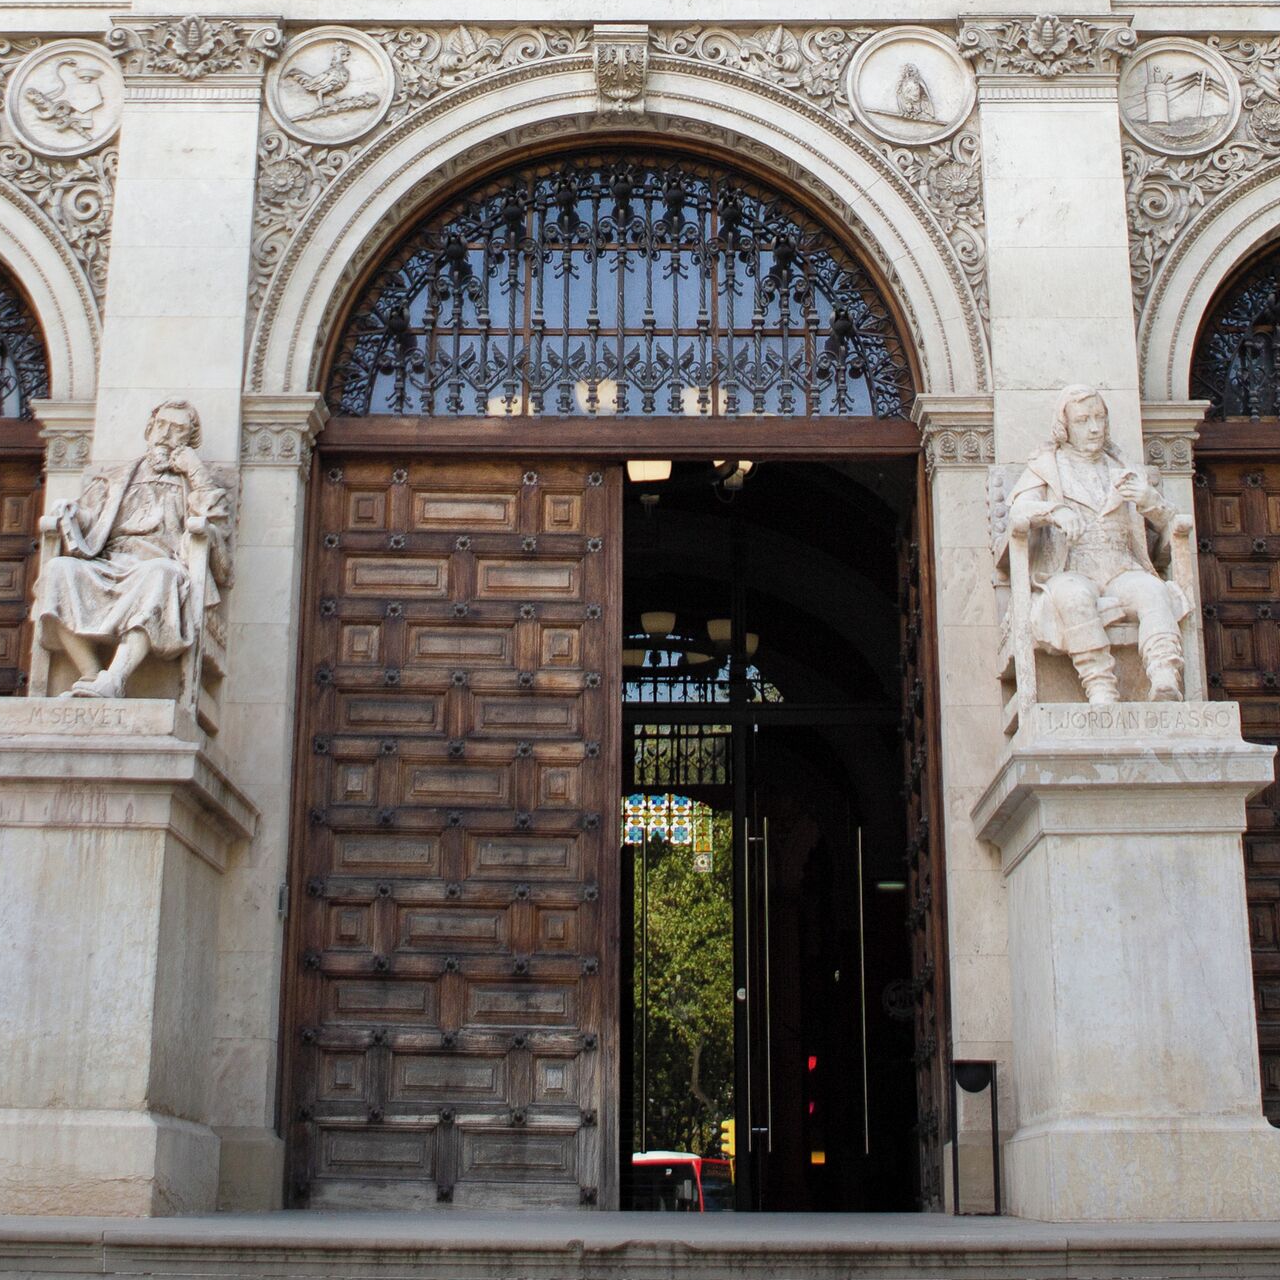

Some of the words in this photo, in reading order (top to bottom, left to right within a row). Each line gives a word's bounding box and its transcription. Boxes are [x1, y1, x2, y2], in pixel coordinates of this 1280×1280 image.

[1059, 711, 1140, 729] JORDAN
[1145, 711, 1169, 729] DE
[1175, 710, 1232, 728] ASSO
